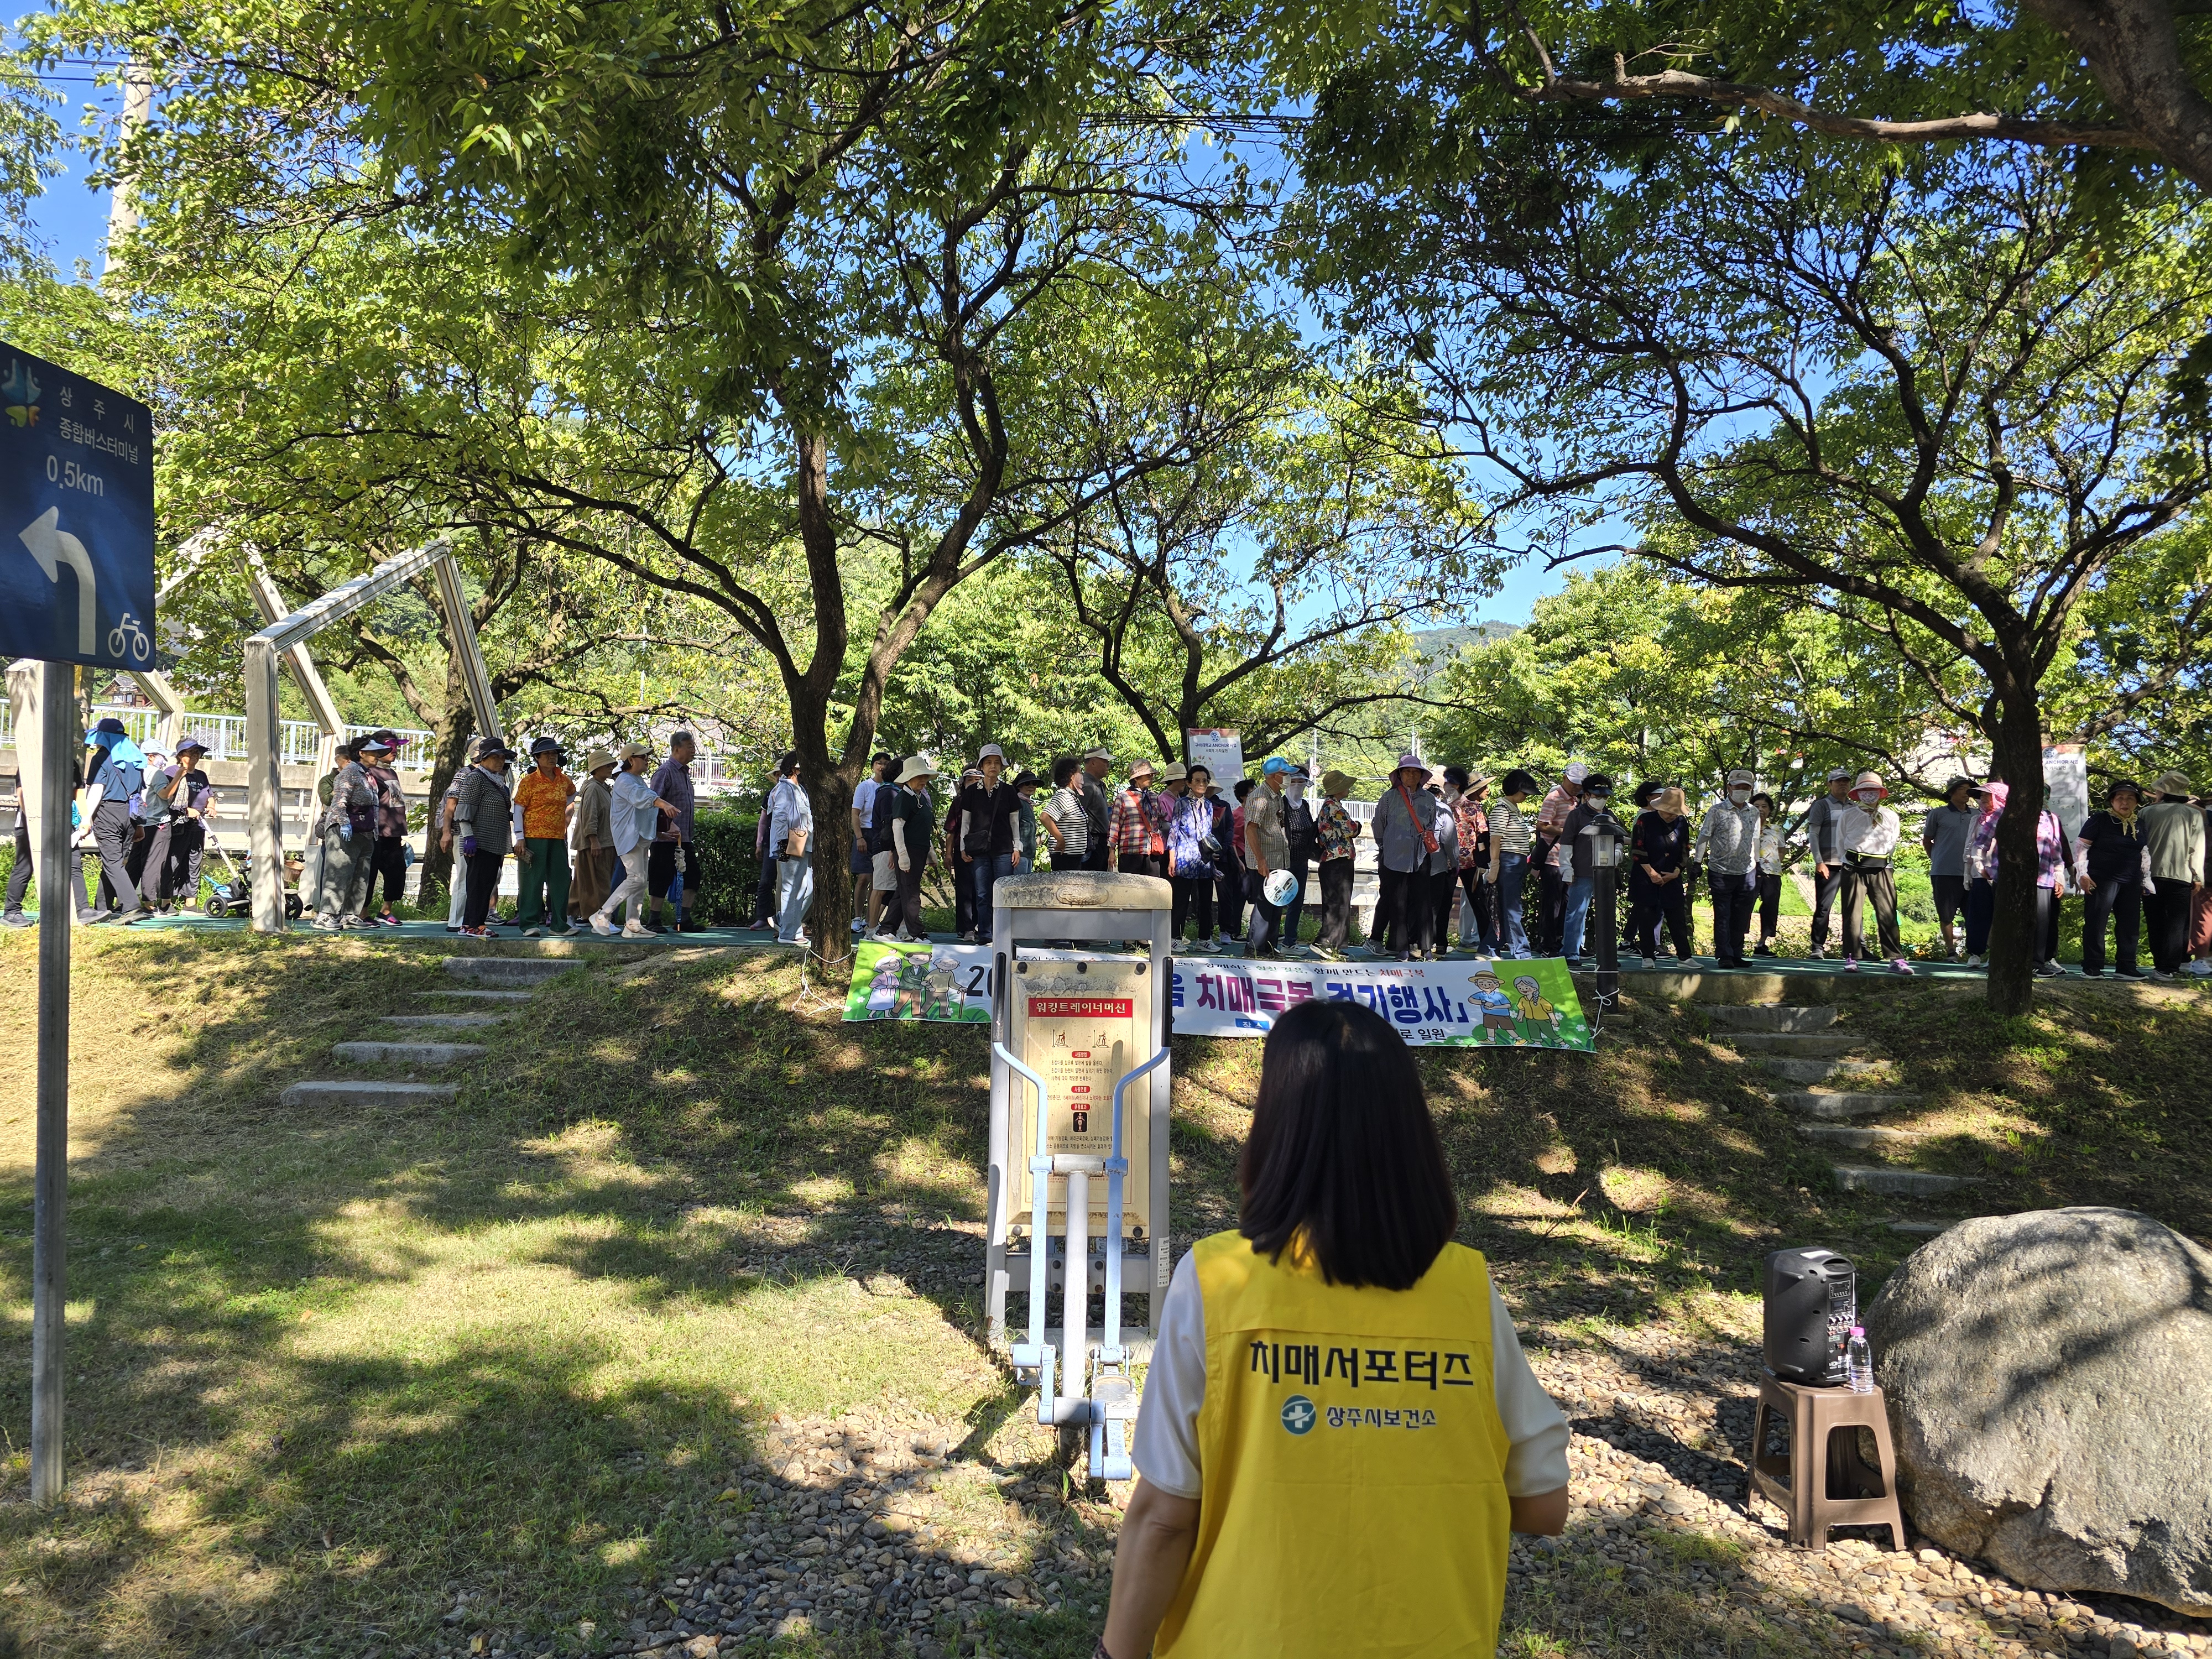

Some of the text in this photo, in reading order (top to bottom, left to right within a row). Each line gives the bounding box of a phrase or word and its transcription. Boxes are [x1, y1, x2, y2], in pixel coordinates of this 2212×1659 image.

[59, 416, 138, 465] 종합버스터미널
[46, 455, 103, 497] 0.5km
[1343, 968, 1375, 977] 만드는
[1379, 968, 1425, 978] 치매극복
[1036, 1002, 1126, 1013] 워킹트레이너머신
[1418, 1029, 1447, 1040] 일원
[1250, 1340, 1474, 1391] 치매서포터즈
[1326, 1406, 1437, 1430] 상주시보건소
